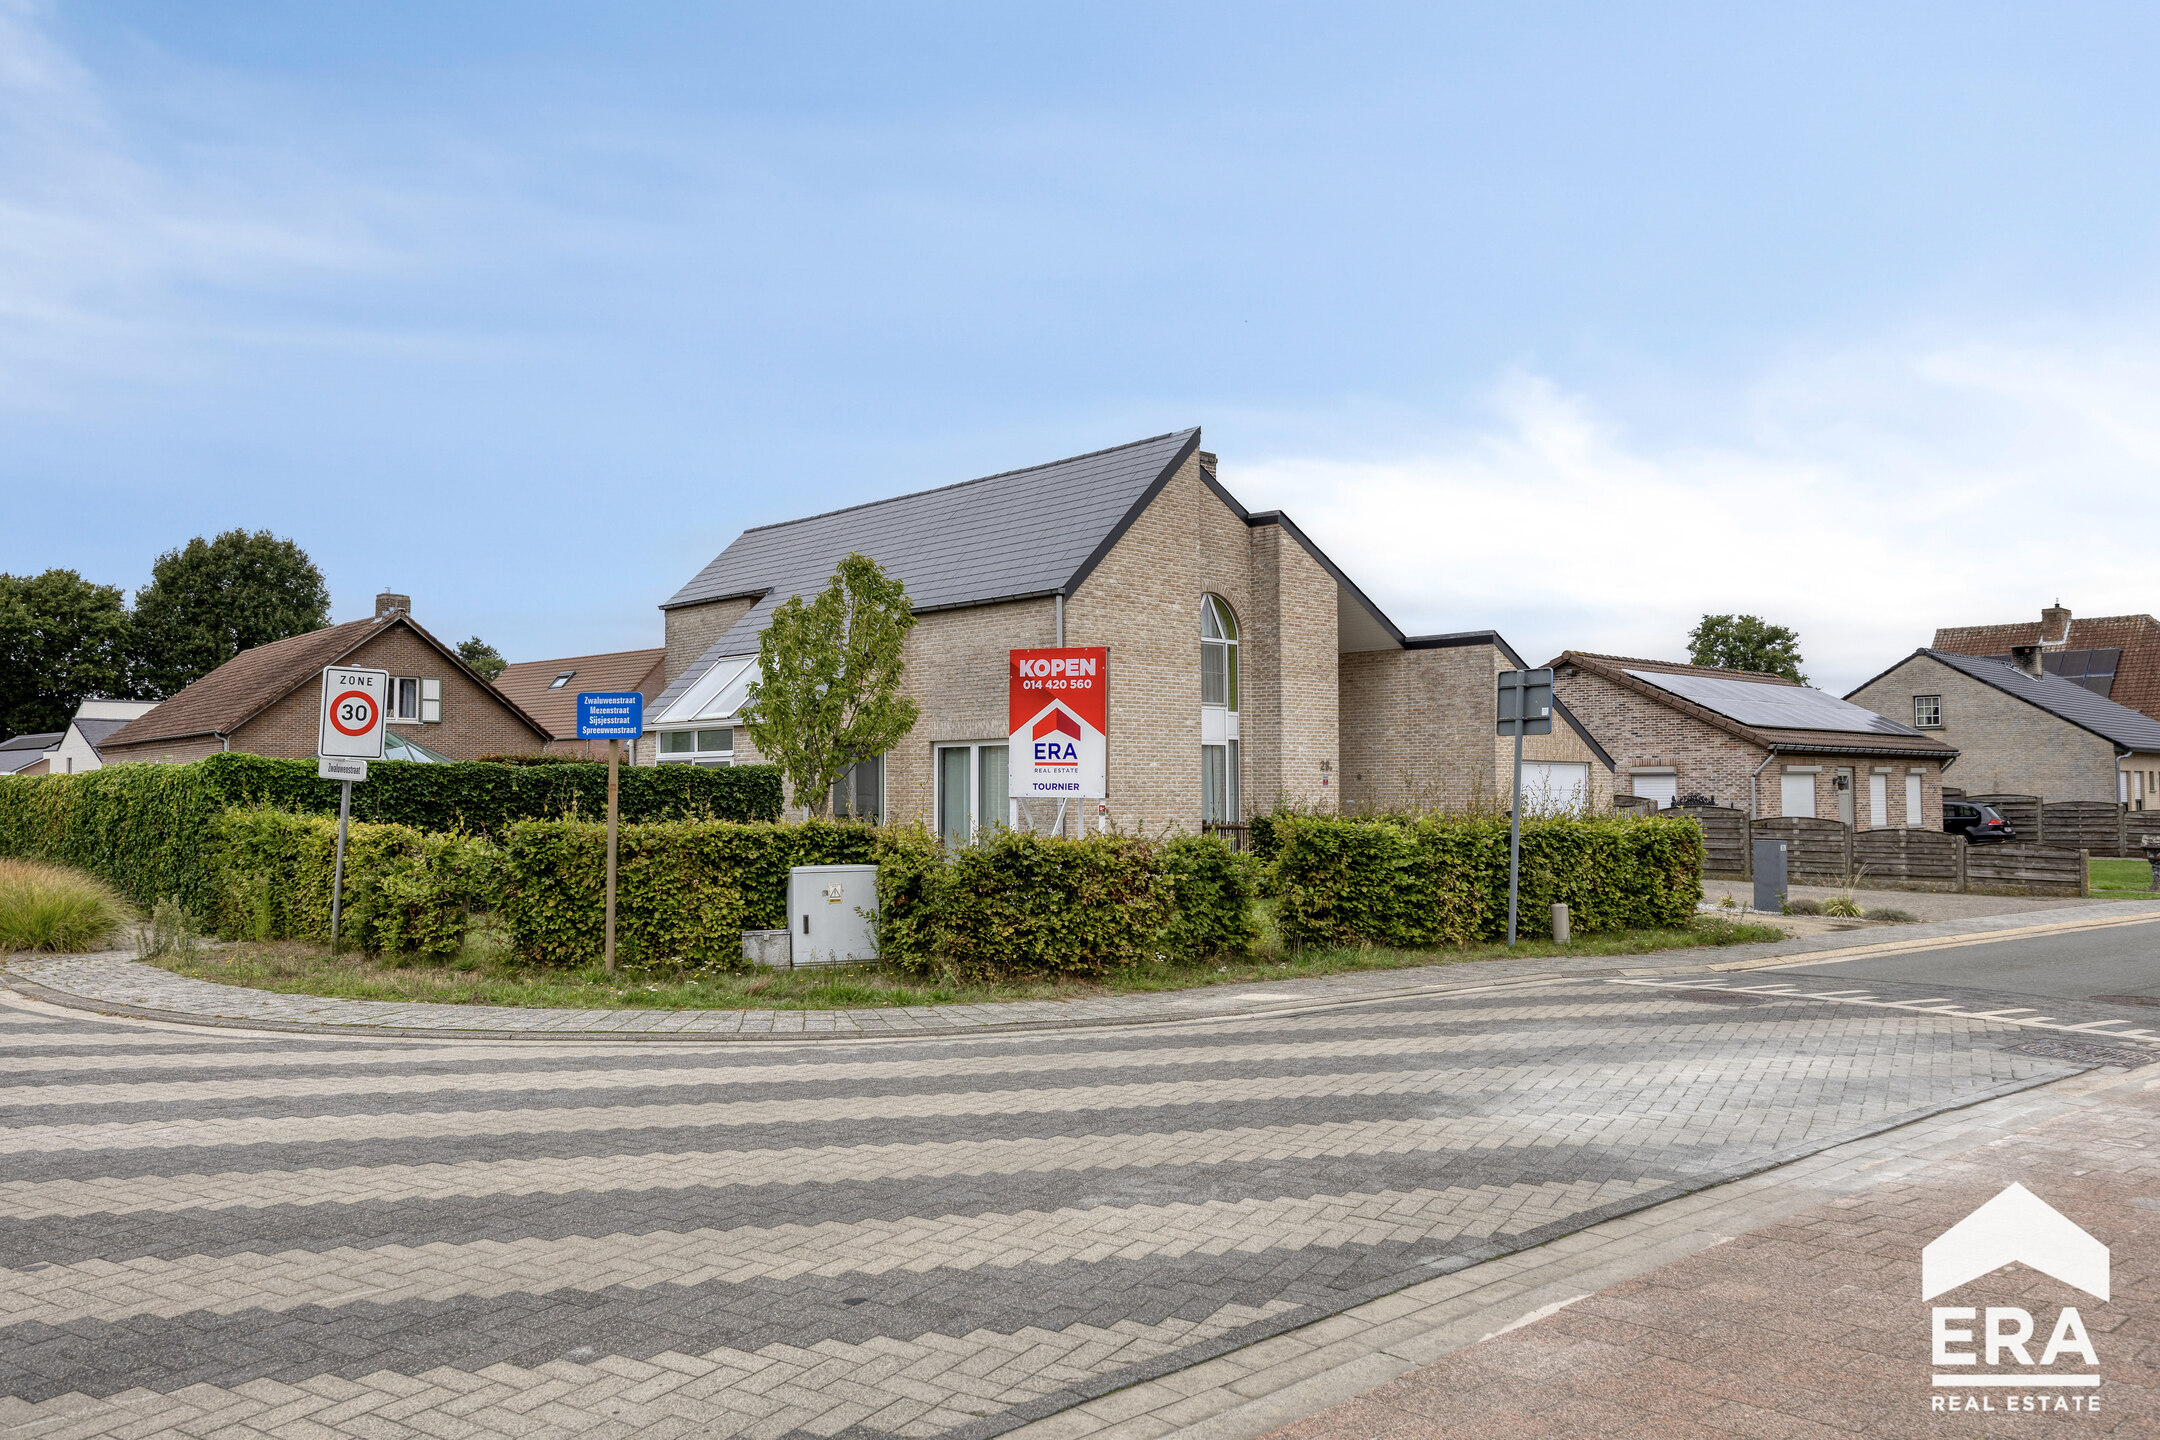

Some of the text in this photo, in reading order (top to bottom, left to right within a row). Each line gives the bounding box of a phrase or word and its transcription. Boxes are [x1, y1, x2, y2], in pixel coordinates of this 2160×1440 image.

[1019, 658, 1096, 678] KOPEN
[340, 675, 374, 687] ZONE
[1023, 679, 1092, 690] 014 420 560
[584, 696, 636, 705] Zwaluwenstraat
[341, 704, 368, 721] 30
[589, 706, 630, 714] Mezenstraat
[589, 716, 630, 726] Sijsjesstraat
[582, 726, 637, 735] Spreeuwenstraat
[1034, 742, 1078, 760] ERA
[327, 763, 361, 775] Zwaluwenstraat
[1033, 782, 1080, 791] TOURNIER
